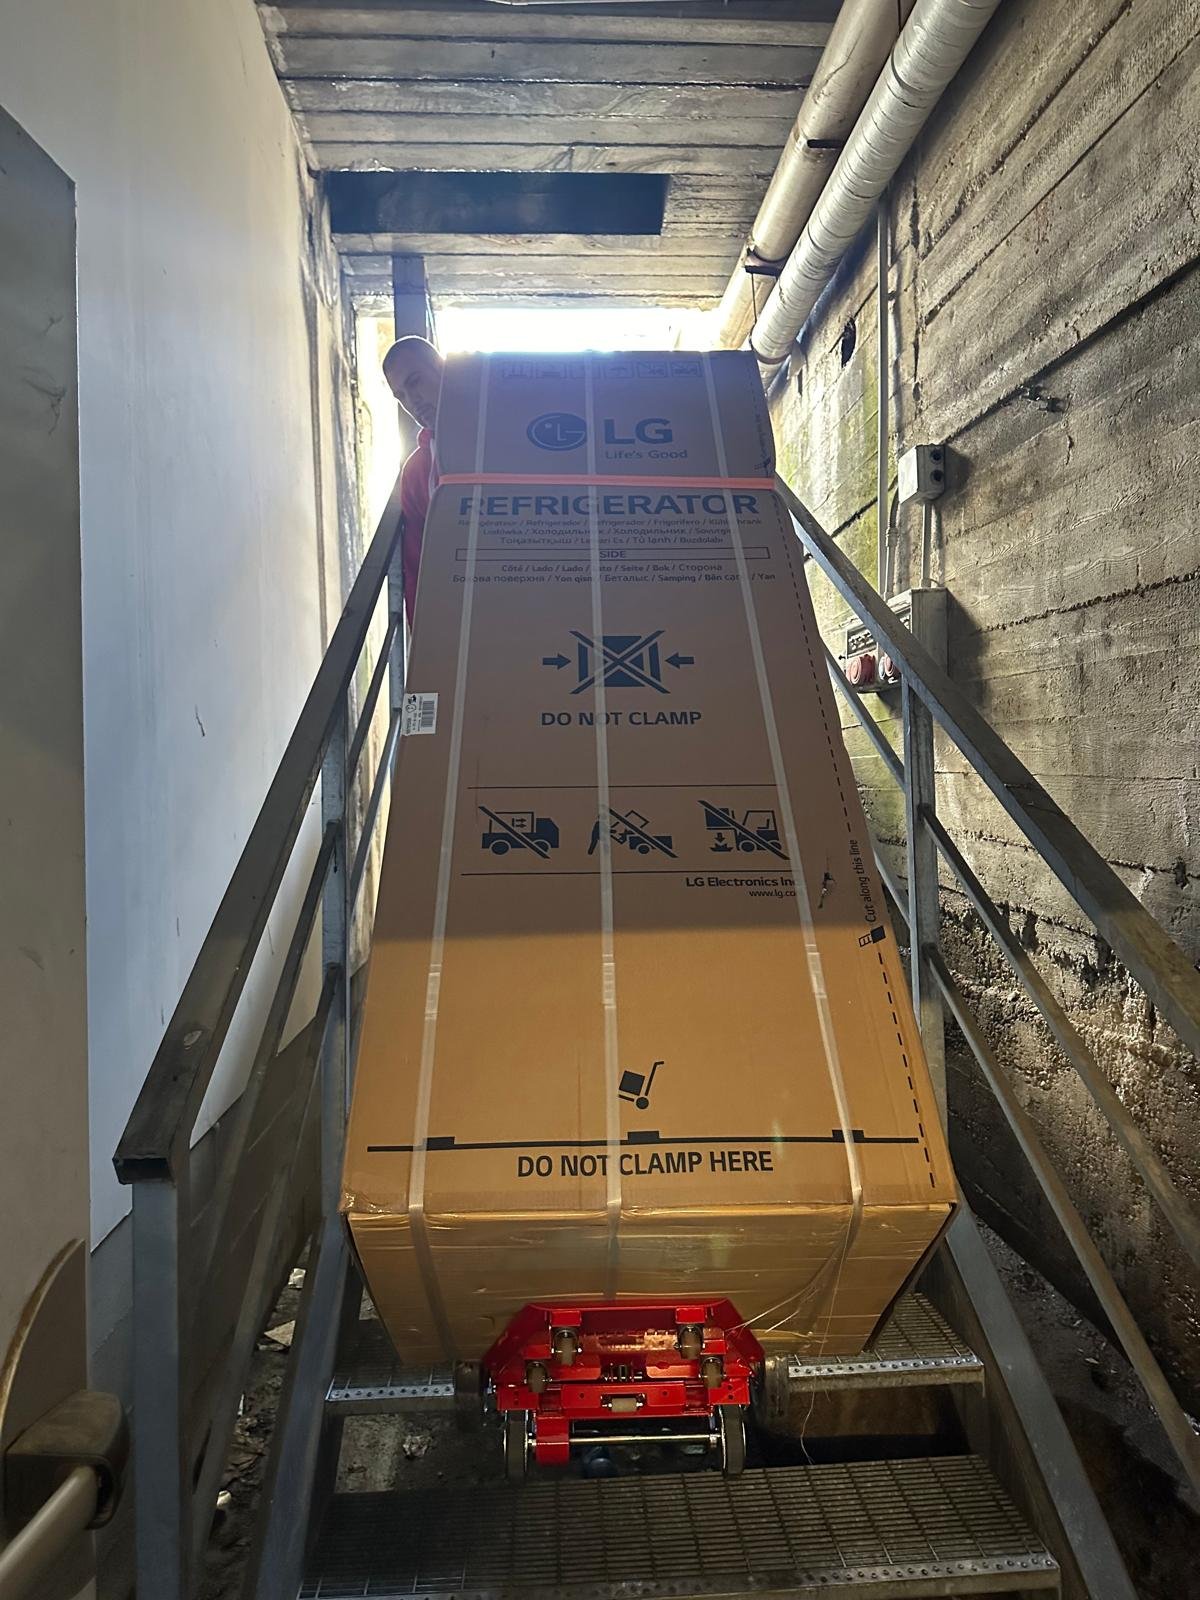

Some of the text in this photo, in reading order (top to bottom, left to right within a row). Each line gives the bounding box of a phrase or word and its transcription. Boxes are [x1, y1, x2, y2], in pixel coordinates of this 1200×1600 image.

[603, 418, 673, 445] LG
[605, 449, 688, 460] Life's Good
[460, 494, 759, 516] REFRIGERATOR
[599, 550, 626, 559] SIDE
[562, 564, 584, 572] Lado
[679, 563, 722, 572] Сторона
[554, 574, 572, 582] Yon
[657, 574, 696, 584] Samping
[757, 573, 776, 581] Yan
[541, 711, 572, 726] DO
[628, 710, 702, 726] CLAMP
[686, 877, 705, 888] LG
[707, 876, 779, 888] Electronics
[849, 839, 877, 923] Cut along this line
[517, 1150, 774, 1177] DO NOT CLAMP HERE
